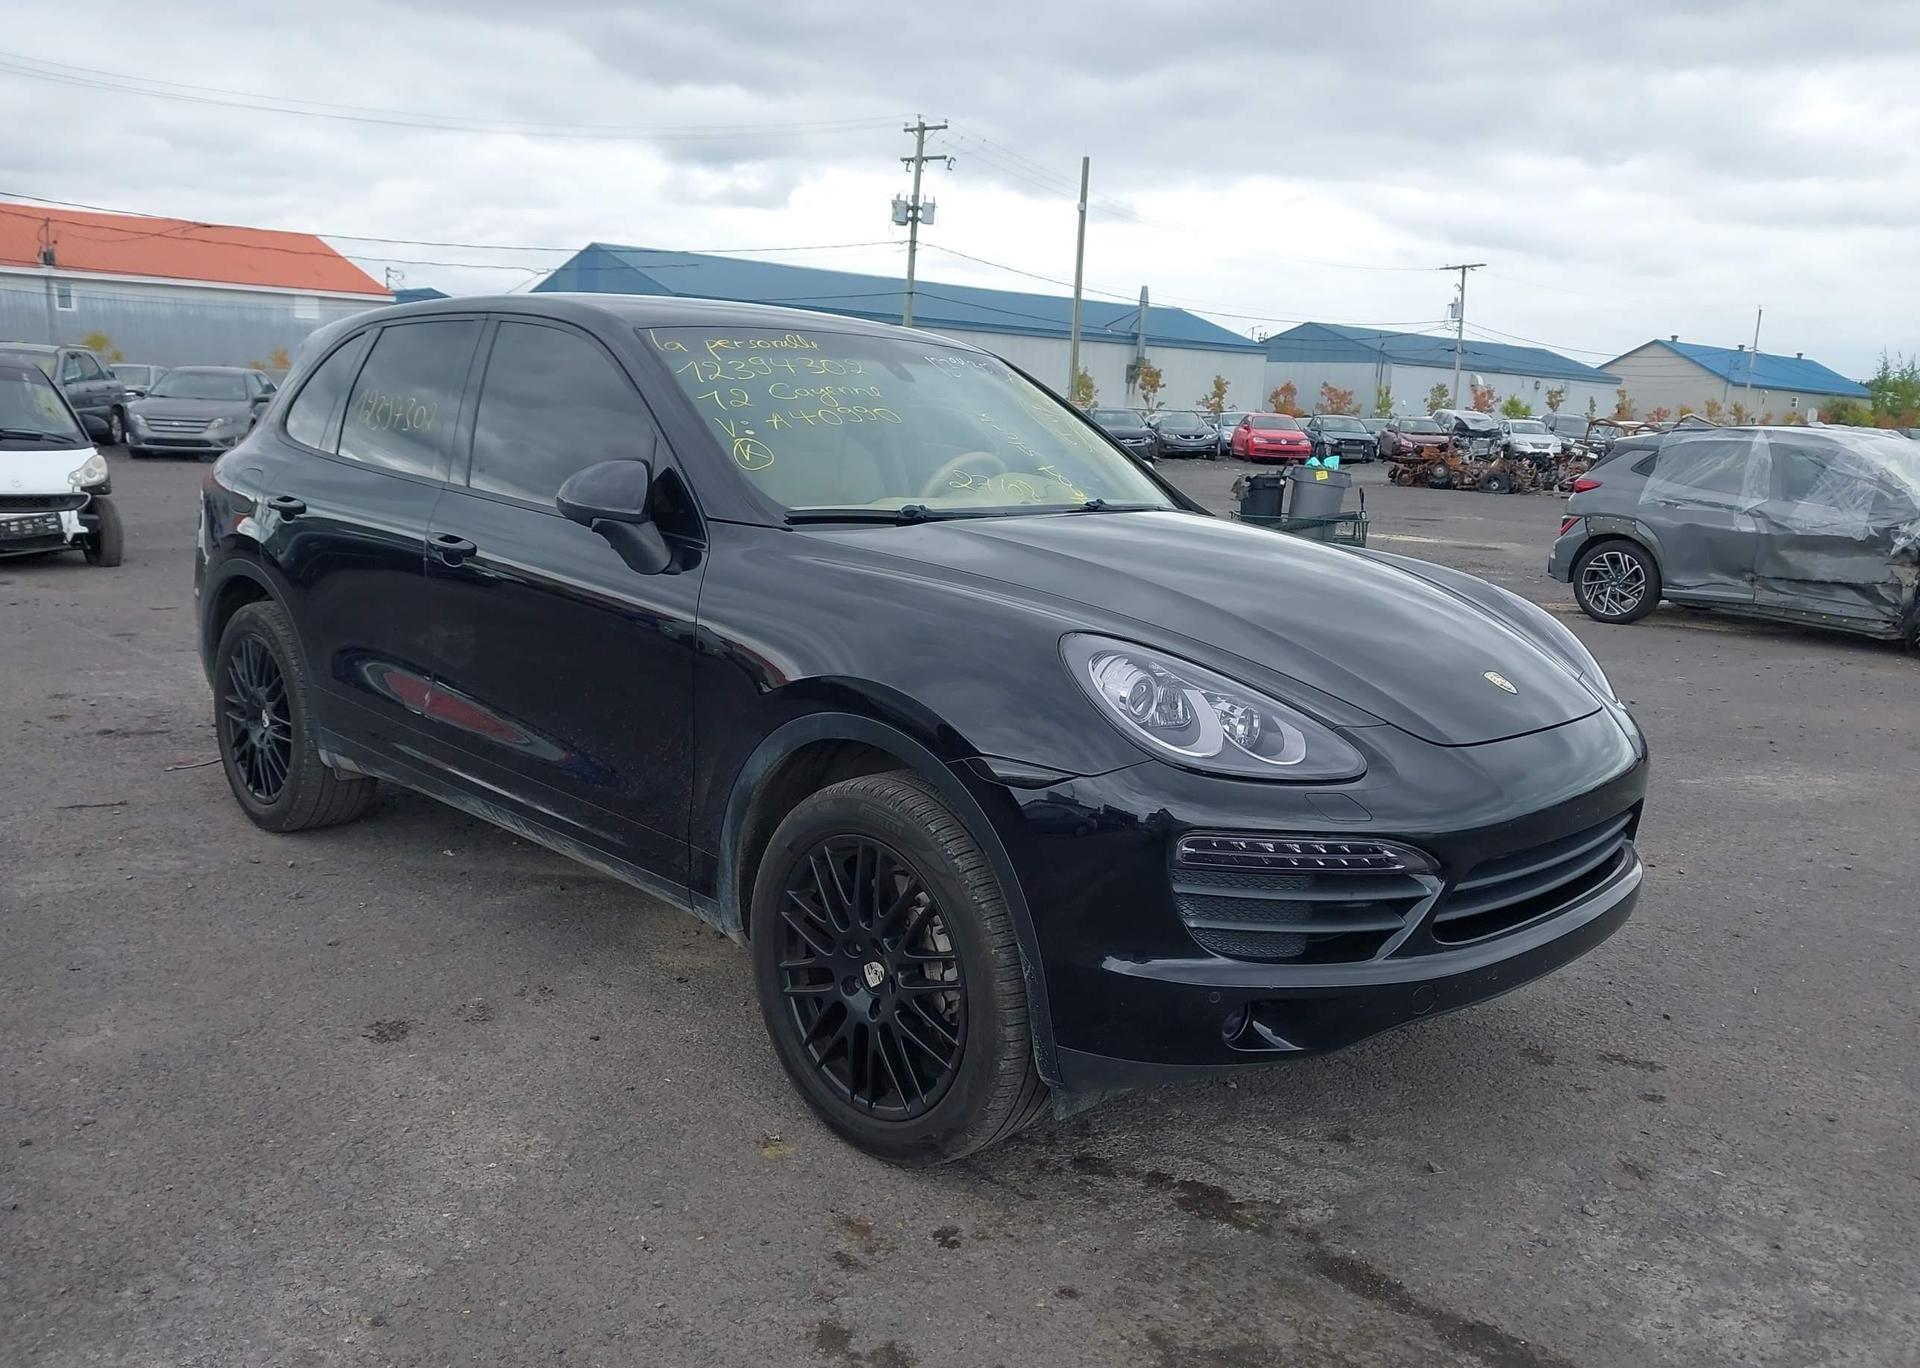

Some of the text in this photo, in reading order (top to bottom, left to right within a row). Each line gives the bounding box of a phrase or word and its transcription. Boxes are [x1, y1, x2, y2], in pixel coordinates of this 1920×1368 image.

[676, 356, 866, 383] 12394302
[697, 382, 883, 411] 12 Cayenne
[765, 406, 903, 430] A40990
